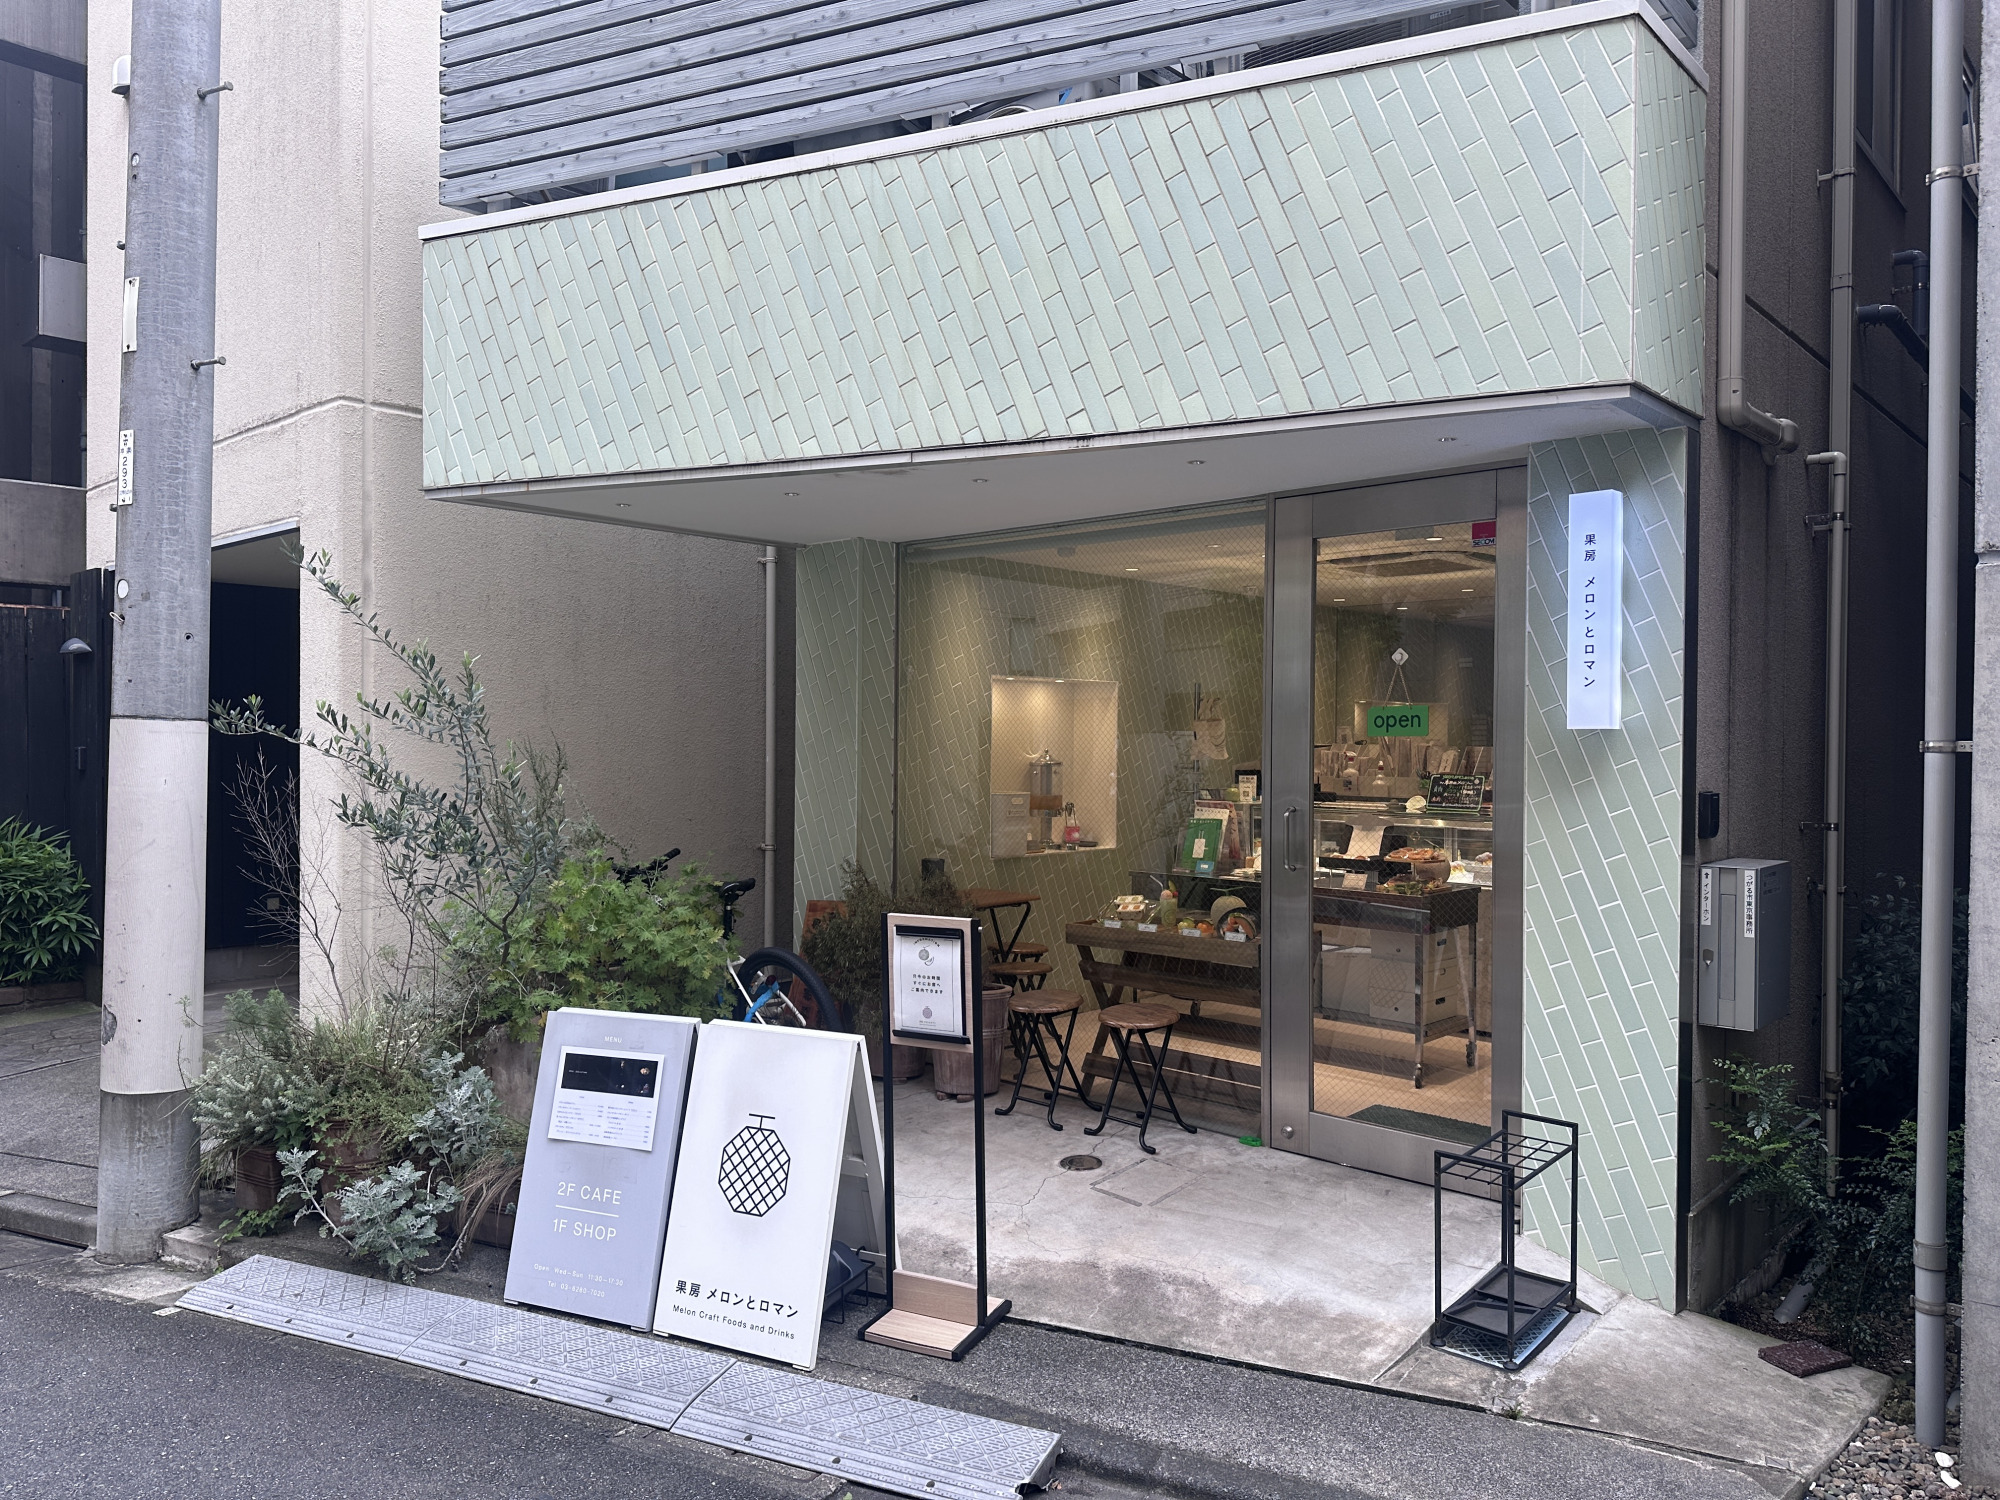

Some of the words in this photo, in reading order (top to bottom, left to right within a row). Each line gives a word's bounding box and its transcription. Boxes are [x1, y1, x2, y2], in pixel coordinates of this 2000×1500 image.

[1584, 533, 1597, 562] 果房
[1584, 576, 1596, 688] メロンとロマン
[1374, 714, 1421, 733] open
[557, 1181, 576, 1197] 2F
[580, 1185, 622, 1205] CAFE
[553, 1218, 568, 1233] 1F
[573, 1222, 617, 1241] SHOP
[534, 1264, 550, 1272] Open
[675, 1280, 701, 1298] 果房
[706, 1288, 798, 1318] メロンとロマン
[673, 1304, 696, 1317] Melon
[699, 1310, 720, 1323] Craft
[722, 1316, 747, 1329] Foods
[750, 1323, 765, 1333] and
[768, 1326, 795, 1340] Drinks
